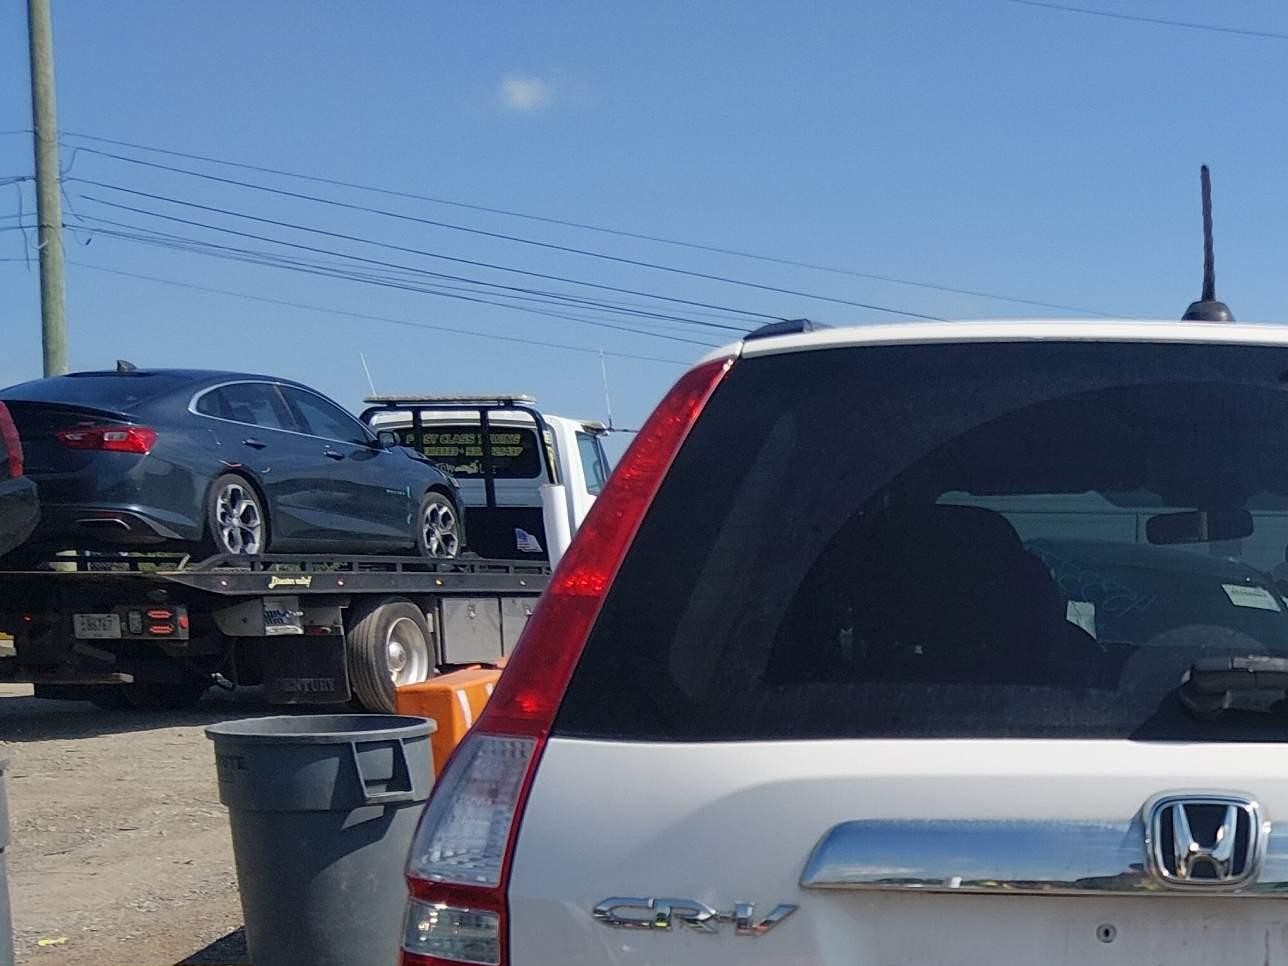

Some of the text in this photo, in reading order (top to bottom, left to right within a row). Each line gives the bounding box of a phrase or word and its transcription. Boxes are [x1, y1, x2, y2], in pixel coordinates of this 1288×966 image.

[406, 433, 440, 445] FST
[440, 433, 476, 445] CLASS
[592, 896, 800, 937] CR-V
